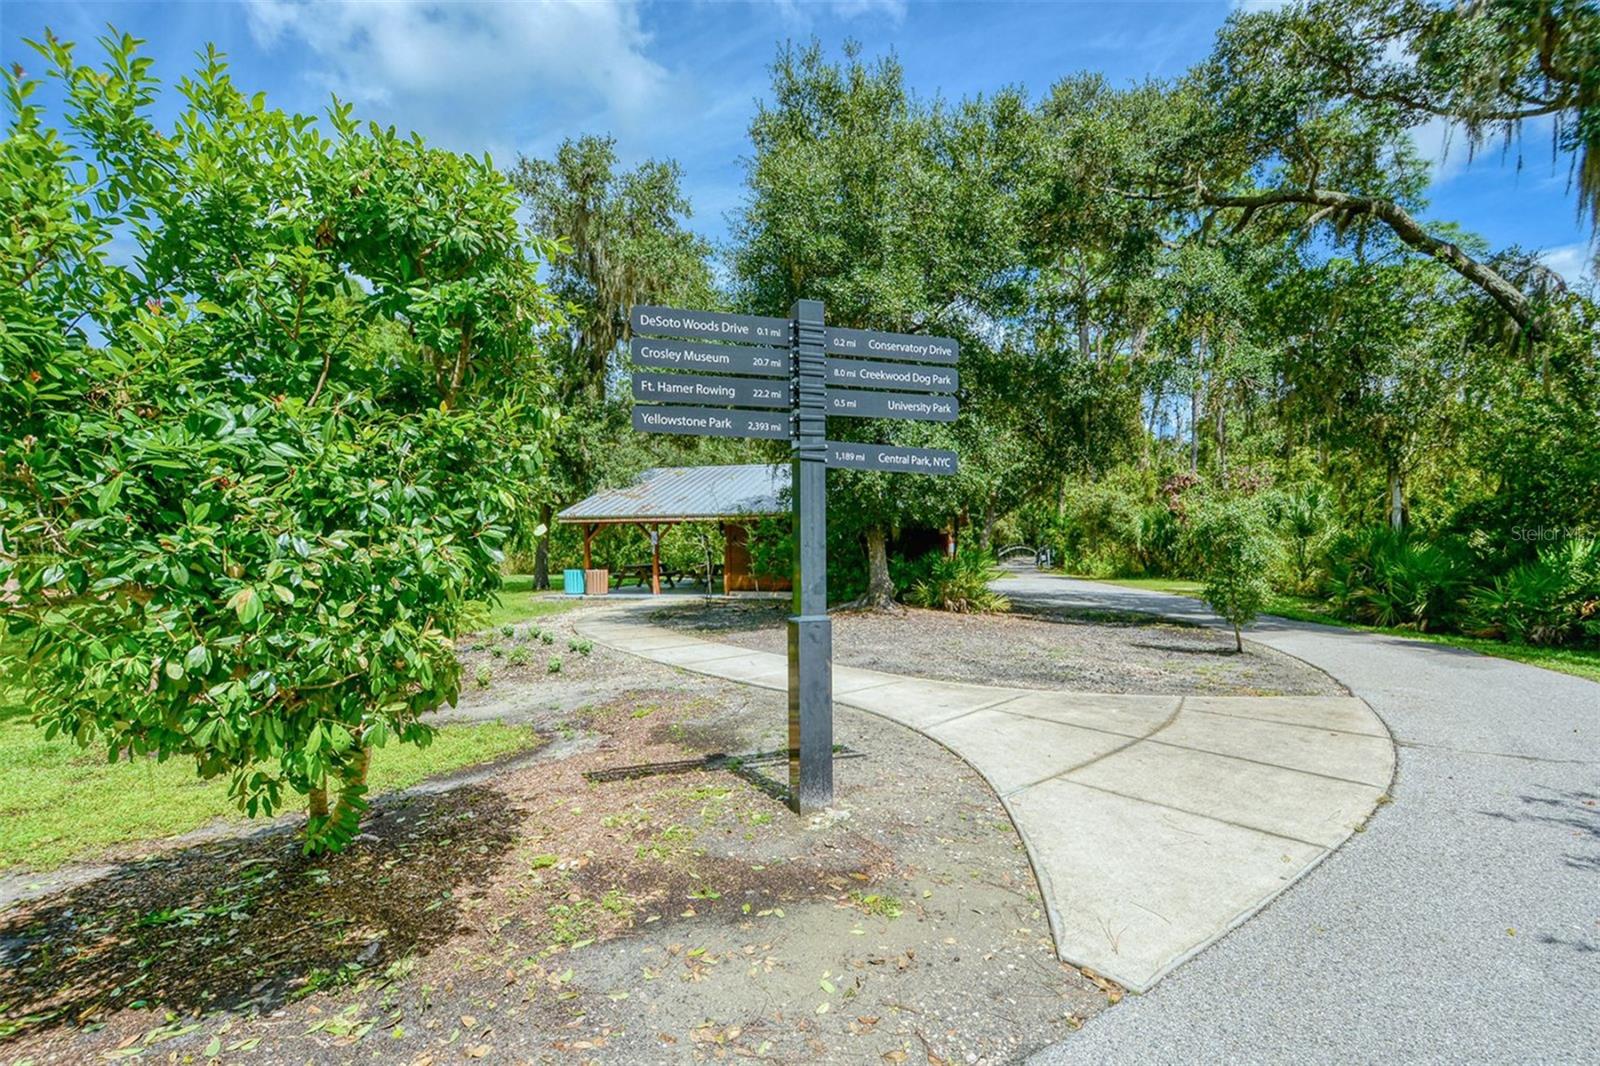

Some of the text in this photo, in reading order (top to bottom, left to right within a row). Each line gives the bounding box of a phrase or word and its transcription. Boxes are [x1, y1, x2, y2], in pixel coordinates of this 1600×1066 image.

[640, 314, 782, 337] DeSoto Woods Drive 0.1 mi
[834, 338, 953, 356] 0.2 mi Conservatory Drive
[640, 346, 782, 368] Crosley Museum 20.7 mi
[833, 368, 952, 385] 8.0 mi Creekwood Dog Park
[640, 380, 782, 399] Ft. Hamer Rowing 22.2 mi
[833, 399, 952, 415] 0.5 mi University Park
[640, 412, 782, 432] Yellowstone Park 2,393 mi
[835, 451, 951, 468] 1,189 mi Central Park, NYC
